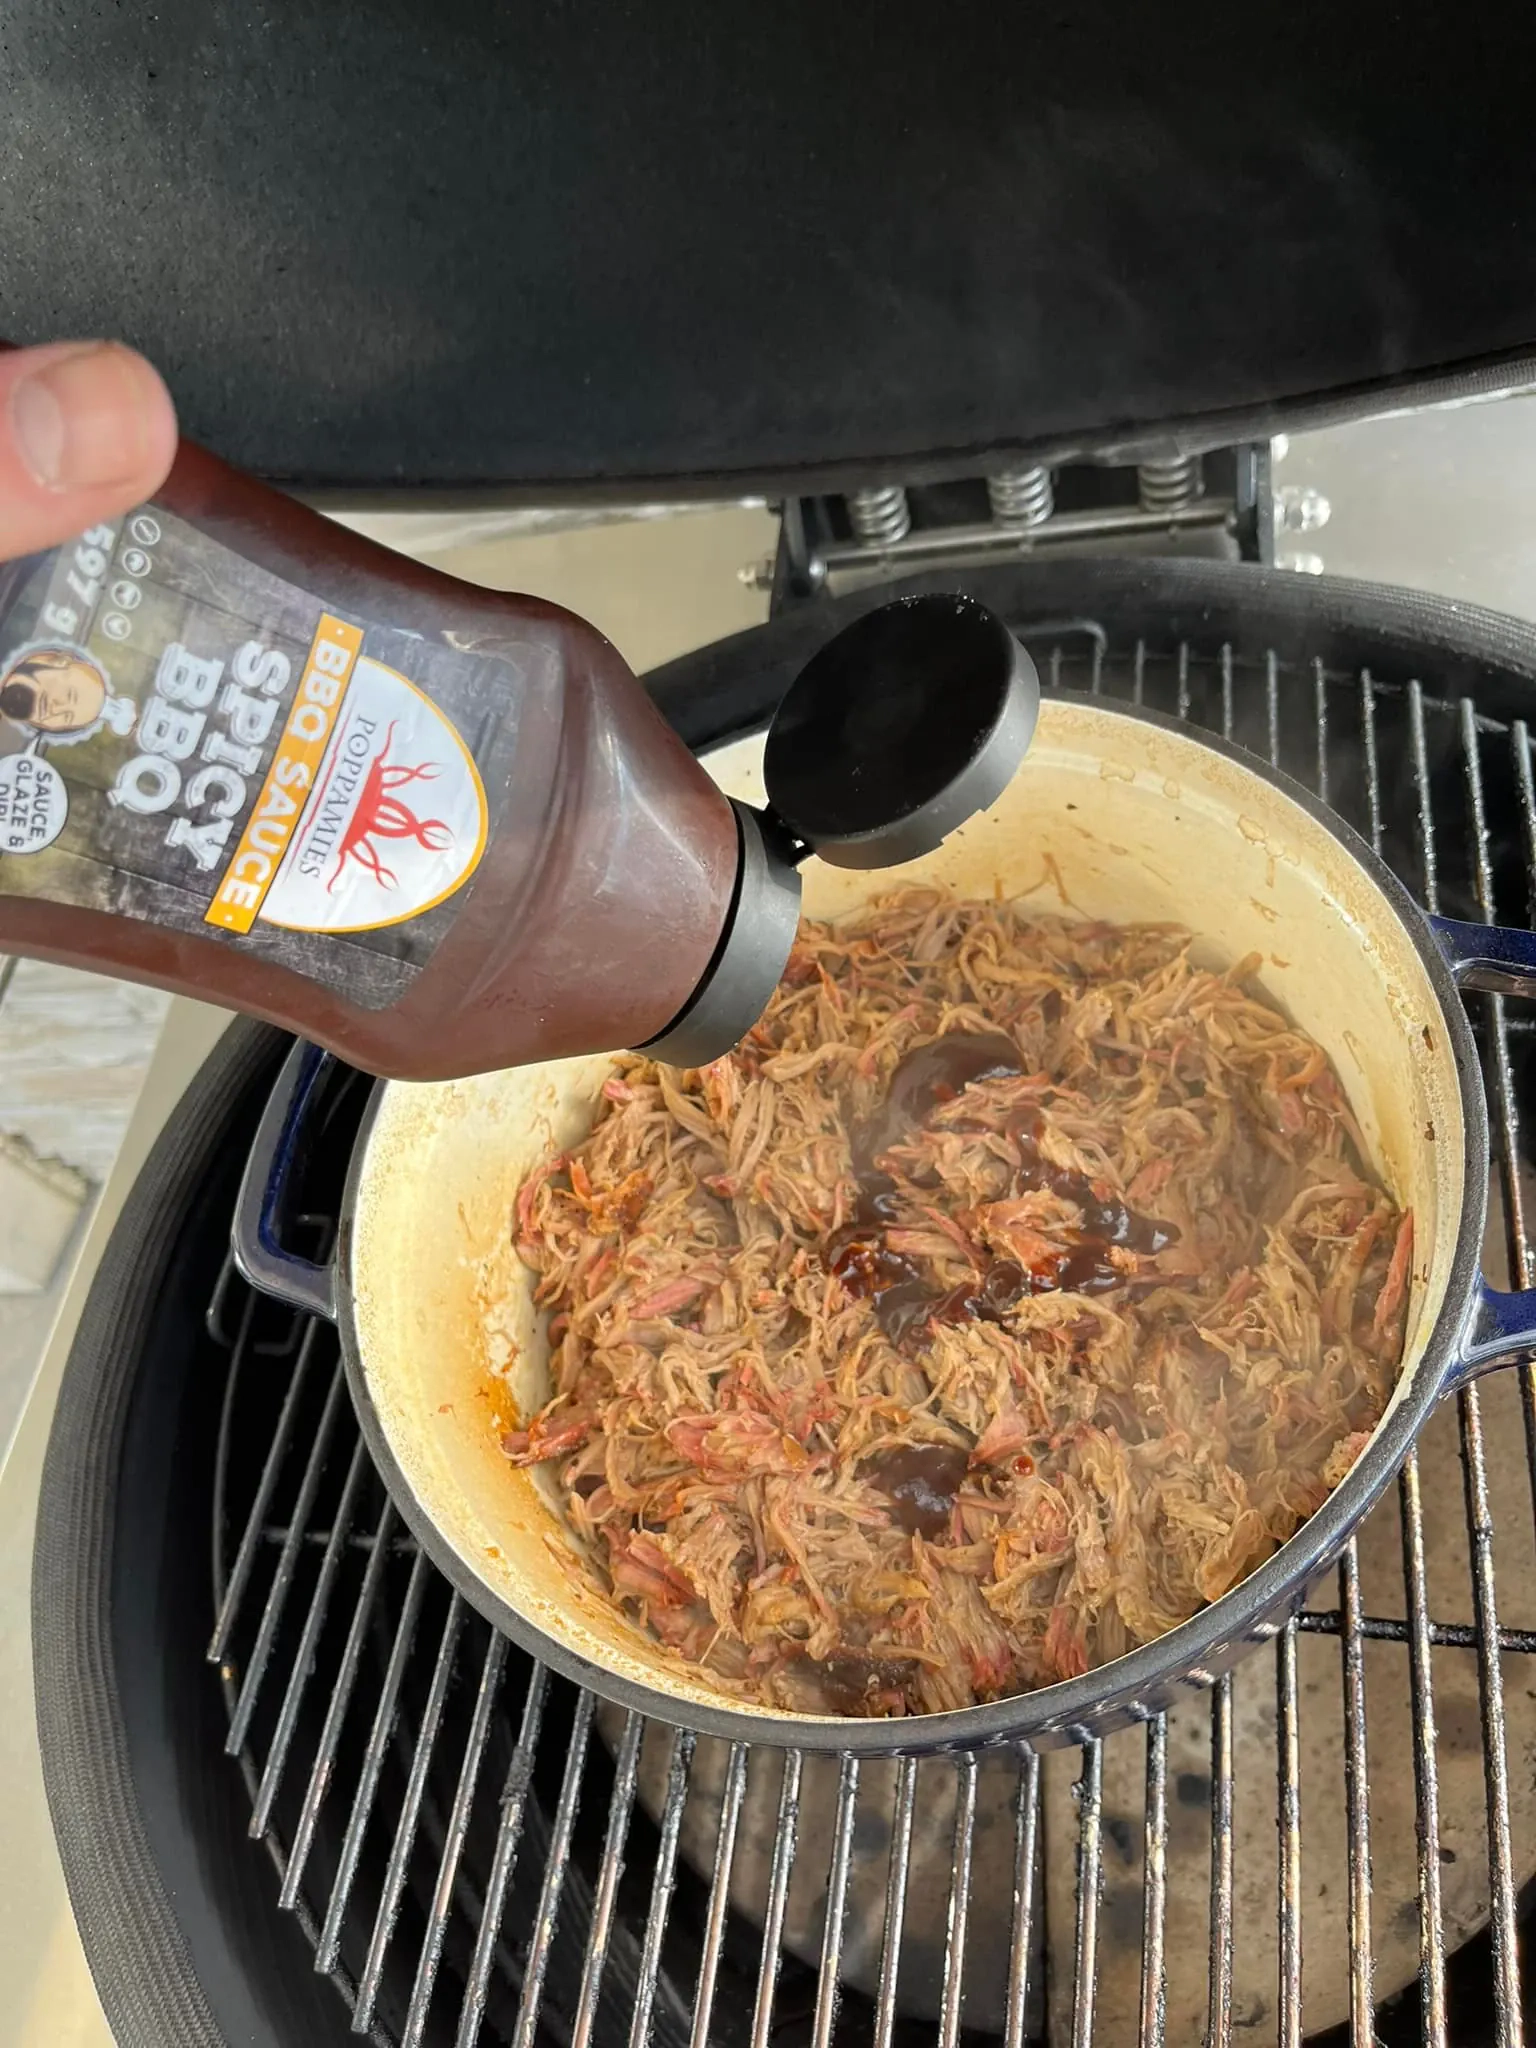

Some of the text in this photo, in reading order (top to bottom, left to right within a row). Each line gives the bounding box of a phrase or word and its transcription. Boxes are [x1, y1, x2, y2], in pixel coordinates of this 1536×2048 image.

[66, 524, 116, 607] 597
[8, 760, 33, 848] GLAZE &
[107, 641, 226, 815] BBQ
[164, 640, 292, 872] SPICY
[219, 639, 351, 909] BBQ SAUCE
[300, 714, 377, 878] POPPAMIES
